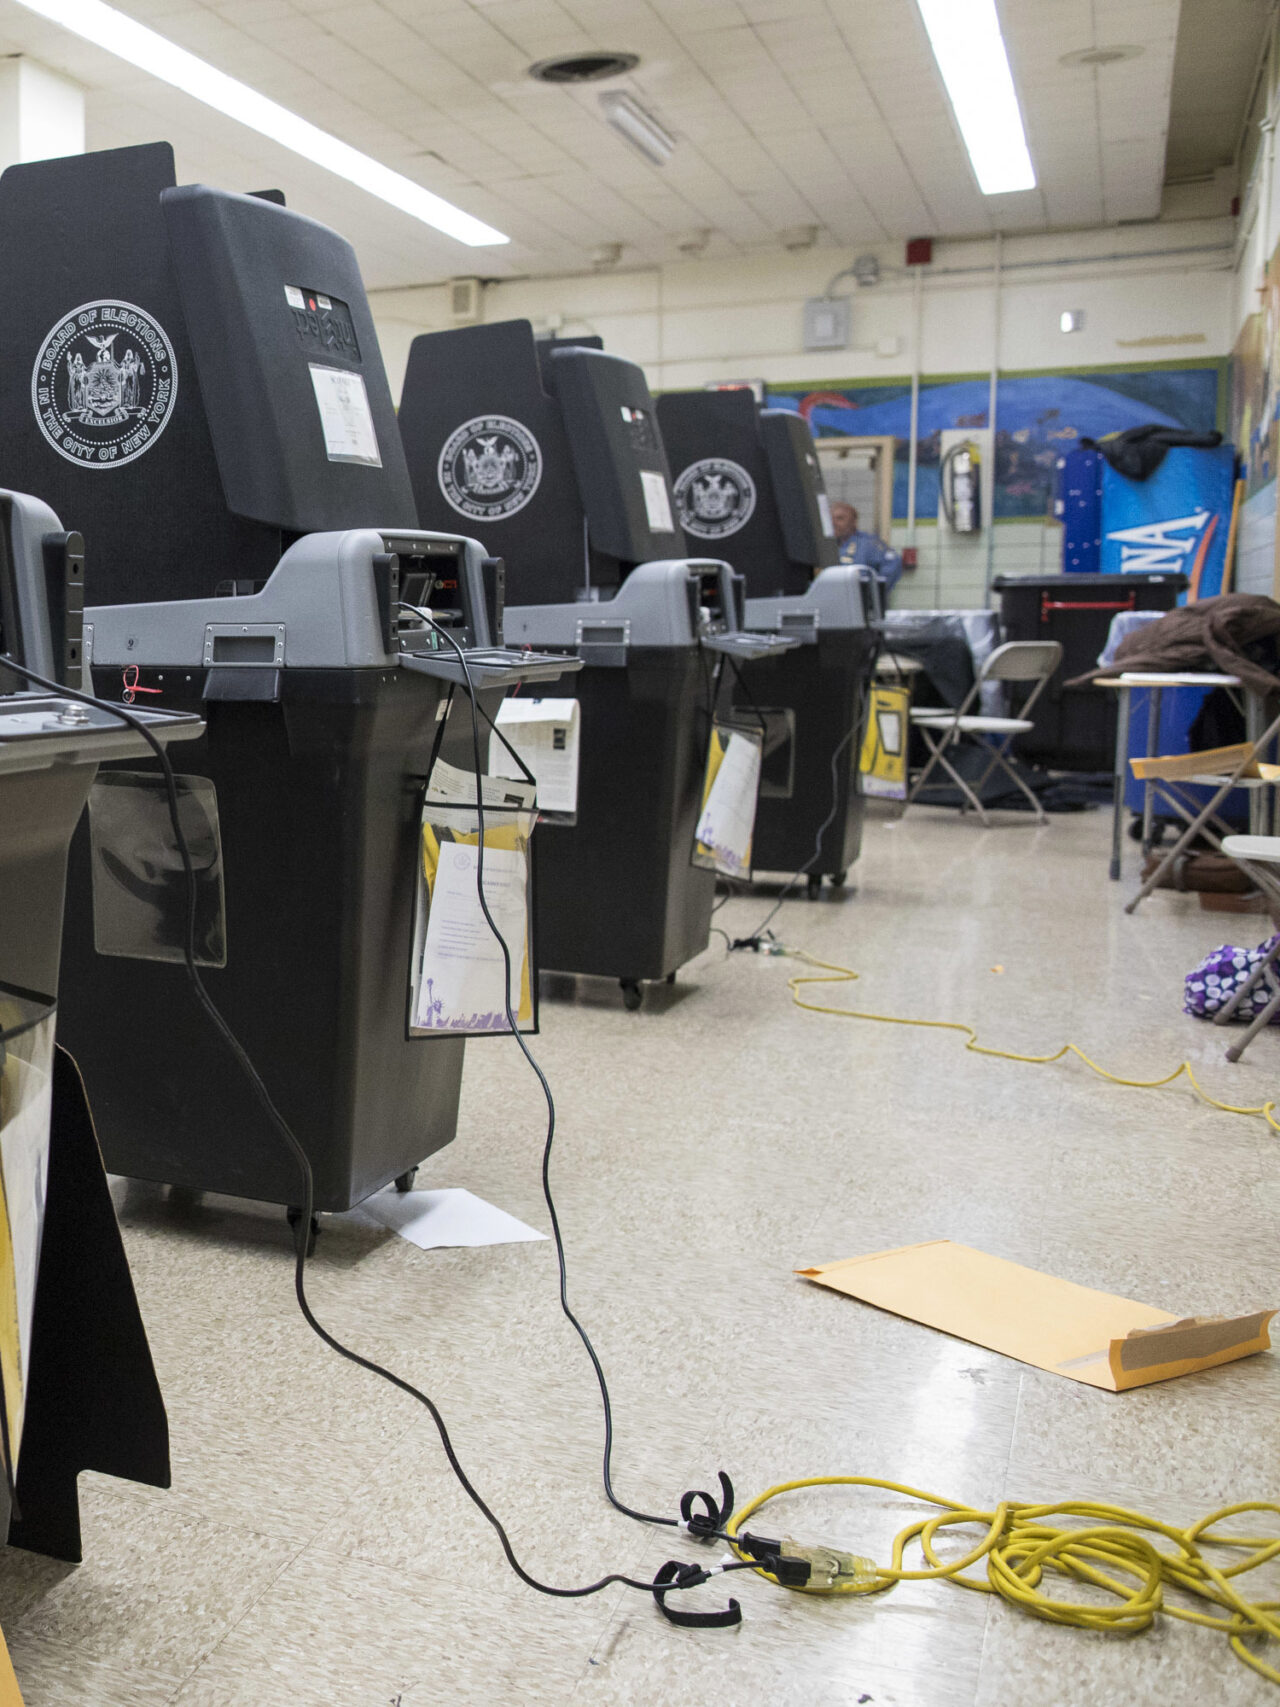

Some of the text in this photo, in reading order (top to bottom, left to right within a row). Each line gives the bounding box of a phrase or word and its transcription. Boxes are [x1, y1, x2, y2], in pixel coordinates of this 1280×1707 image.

[42, 308, 167, 371] BOARD OF ELECTIONS
[38, 378, 171, 461] IN THE CITY OF NEW YORK
